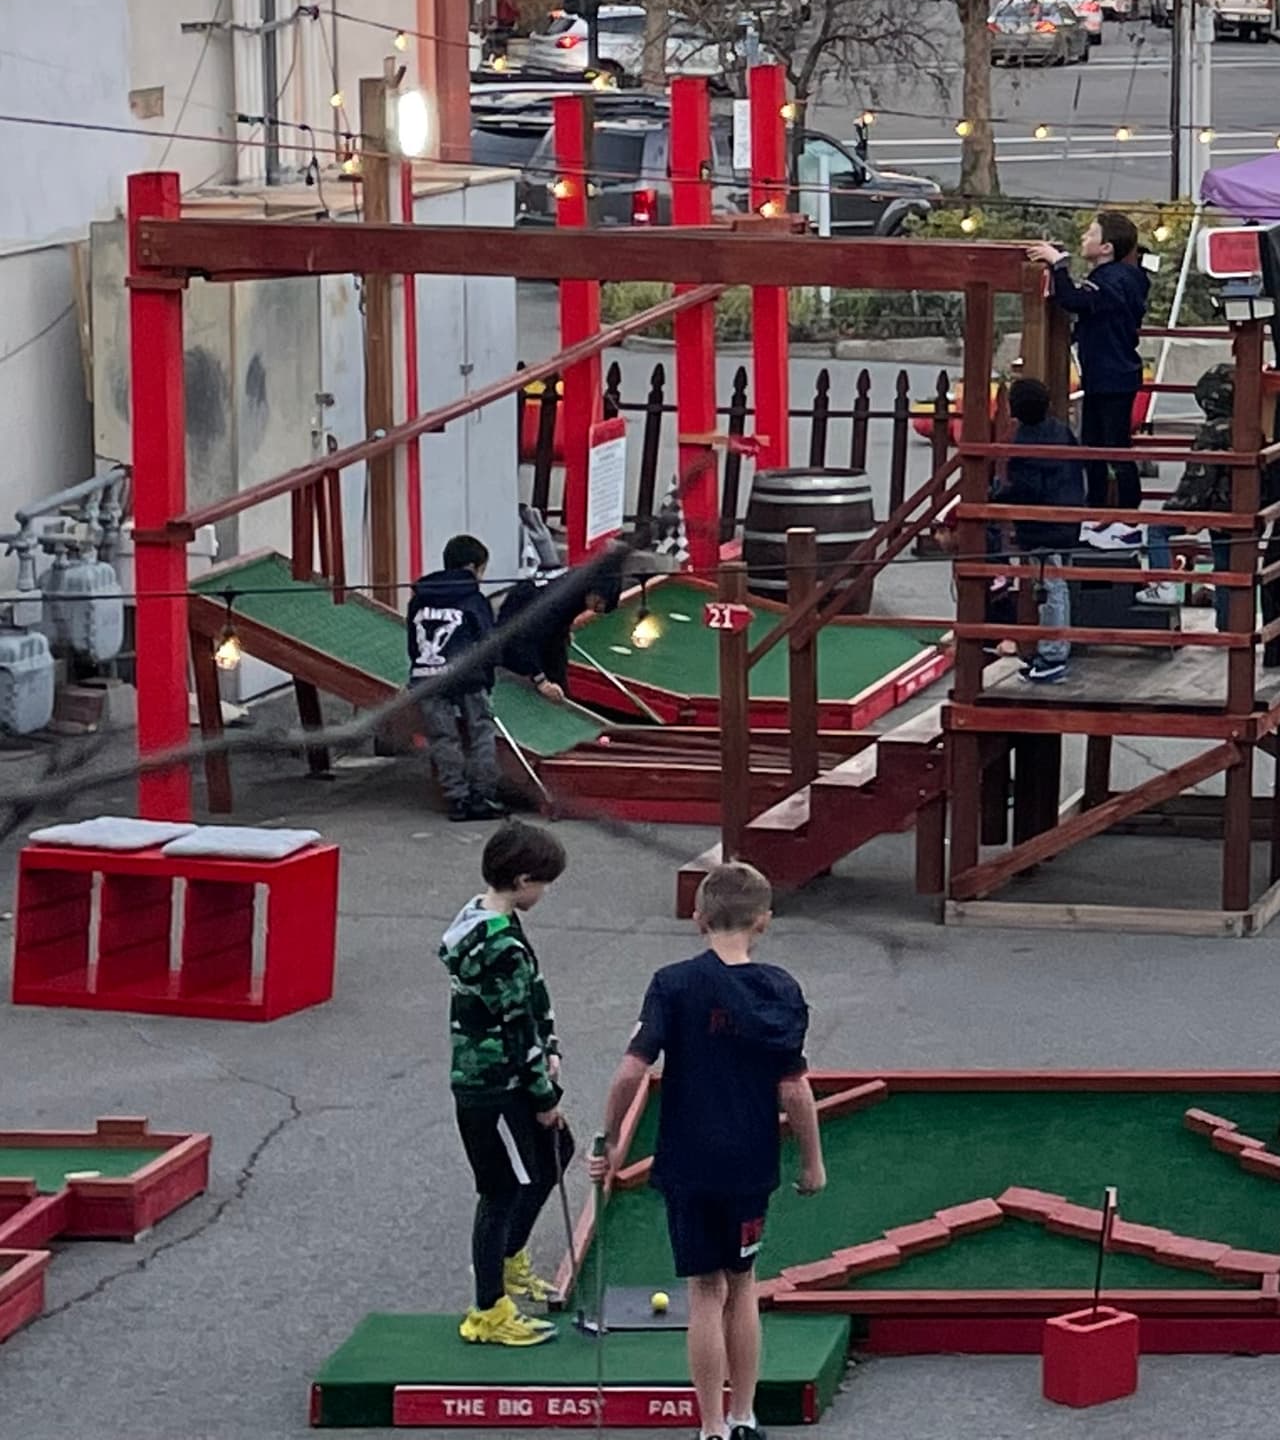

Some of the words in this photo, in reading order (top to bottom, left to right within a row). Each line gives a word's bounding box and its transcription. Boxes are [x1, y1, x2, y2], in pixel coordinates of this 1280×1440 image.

[709, 607, 734, 629] 21
[442, 1398, 486, 1417] THE
[497, 1398, 533, 1417] BIG
[546, 1397, 607, 1417] EASY
[647, 1399, 694, 1417] PAR
